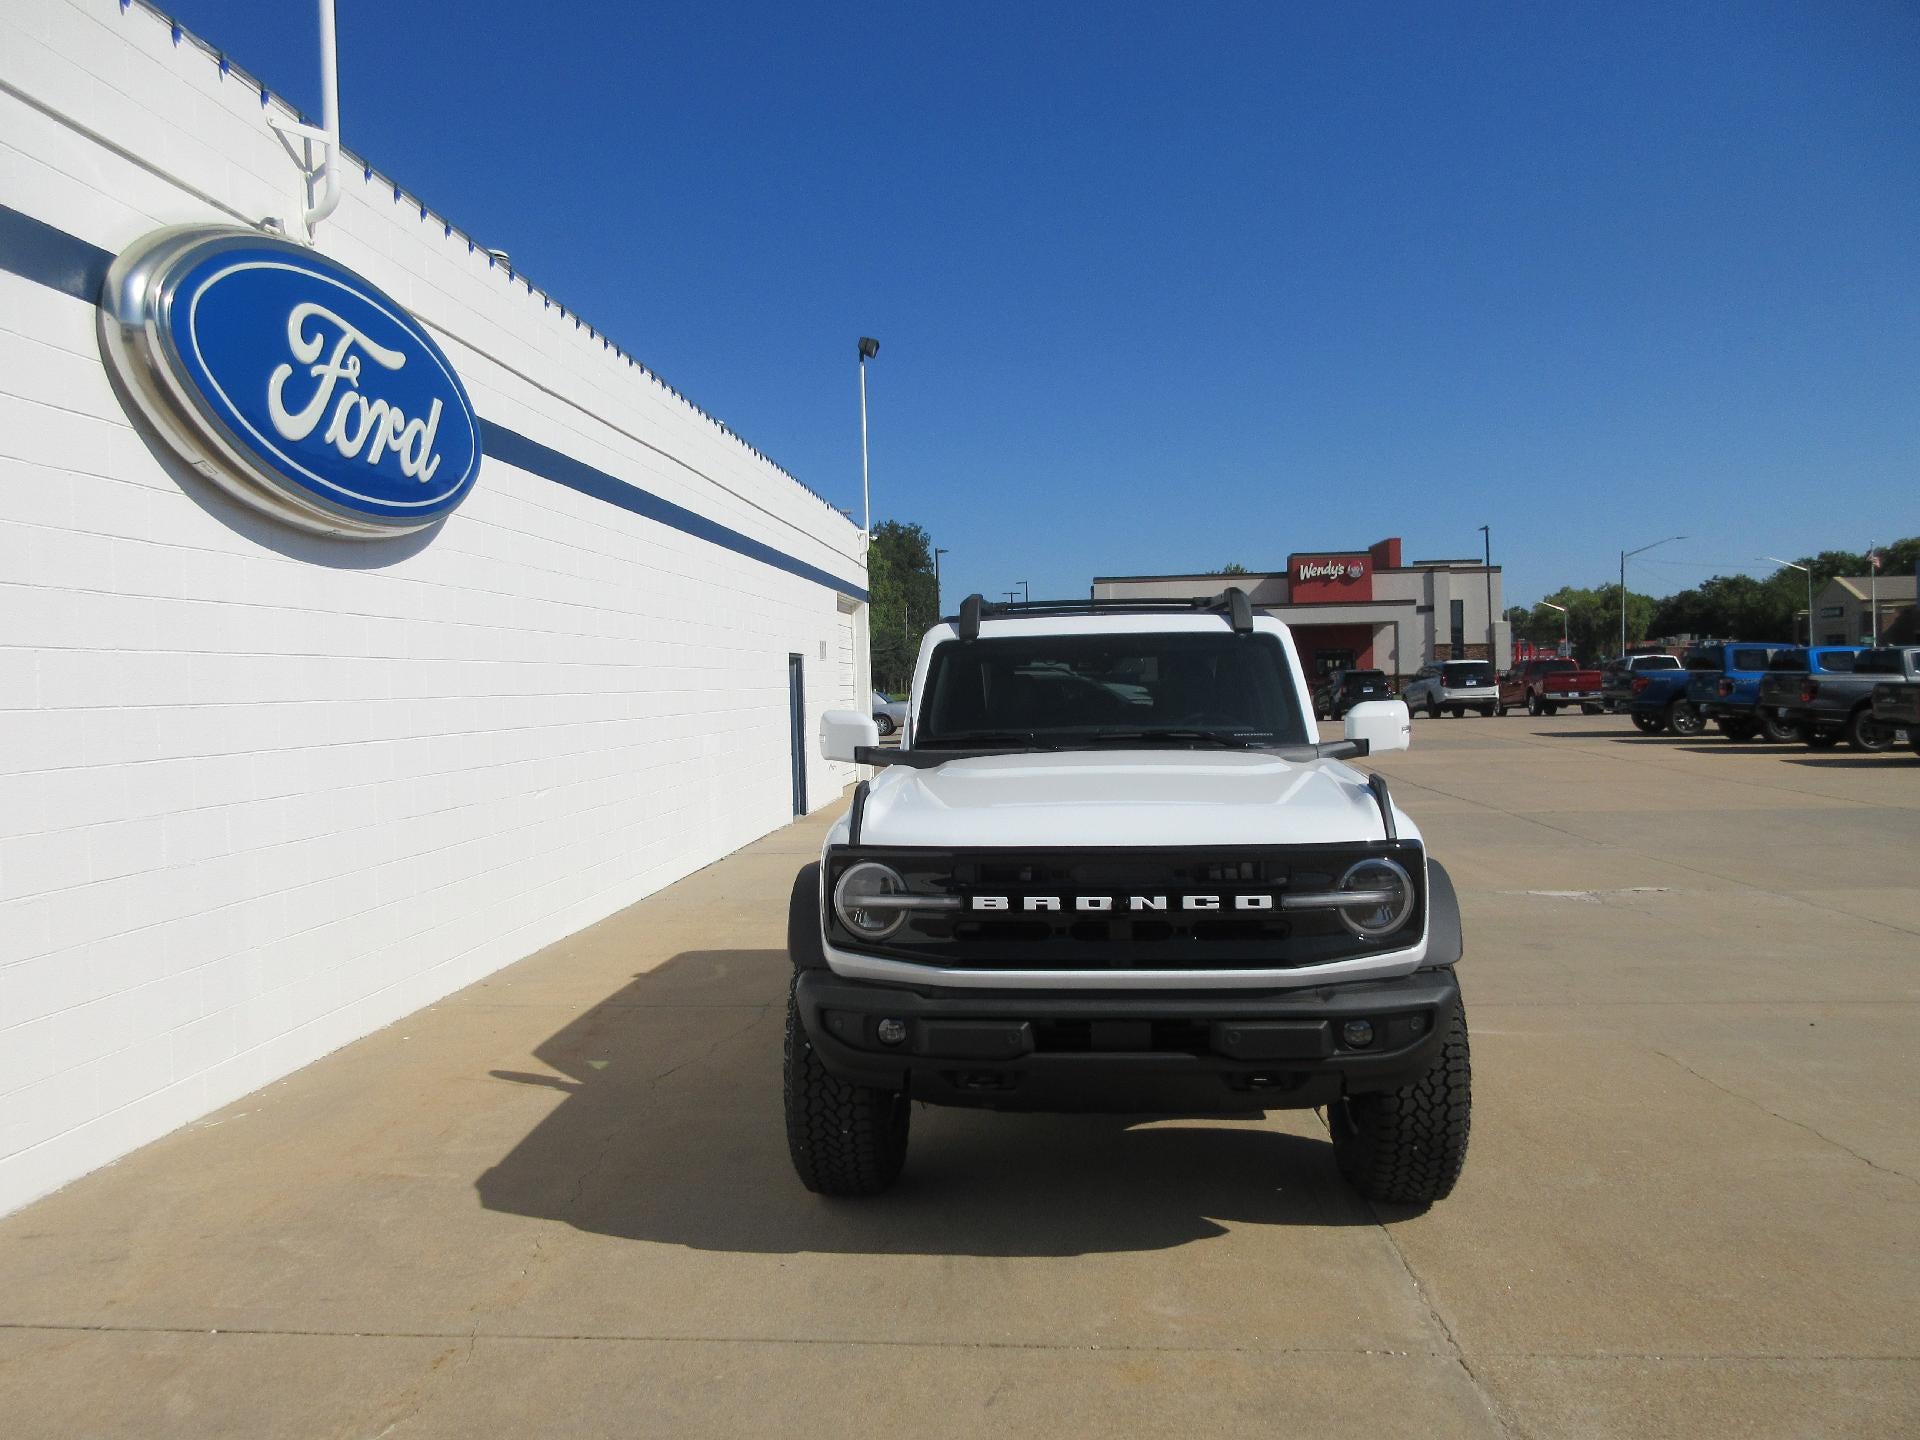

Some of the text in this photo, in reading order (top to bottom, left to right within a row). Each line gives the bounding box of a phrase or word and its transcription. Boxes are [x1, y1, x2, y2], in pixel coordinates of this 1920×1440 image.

[268, 302, 443, 484] Ford
[1300, 561, 1344, 580] Wendy's
[972, 895, 1273, 910] BRONCO
